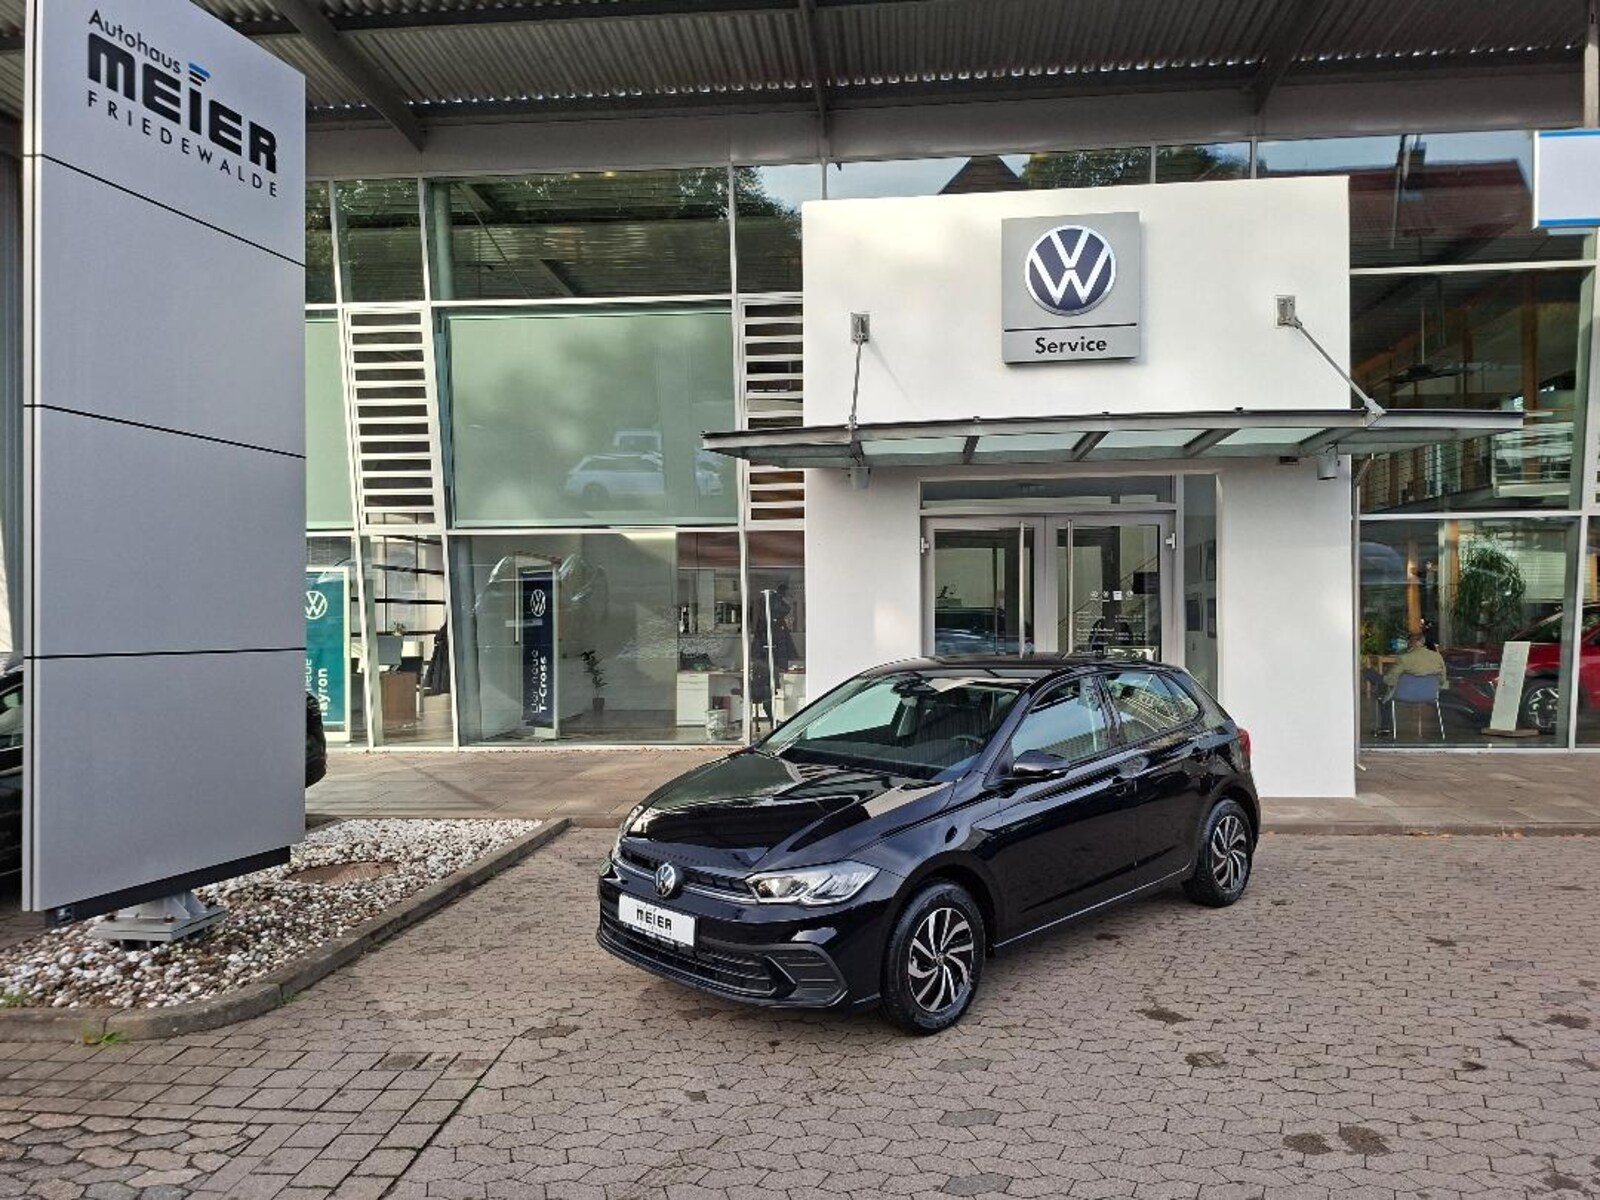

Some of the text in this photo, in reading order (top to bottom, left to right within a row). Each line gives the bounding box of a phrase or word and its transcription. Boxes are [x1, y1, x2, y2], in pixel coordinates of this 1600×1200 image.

[88, 9, 182, 75] Autohaus
[87, 32, 278, 174] MEIER
[87, 90, 278, 198] FRIEDEWALDE
[1035, 336, 1107, 354] Service
[538, 655, 548, 713] T-Cross
[636, 907, 672, 931] MEIER
